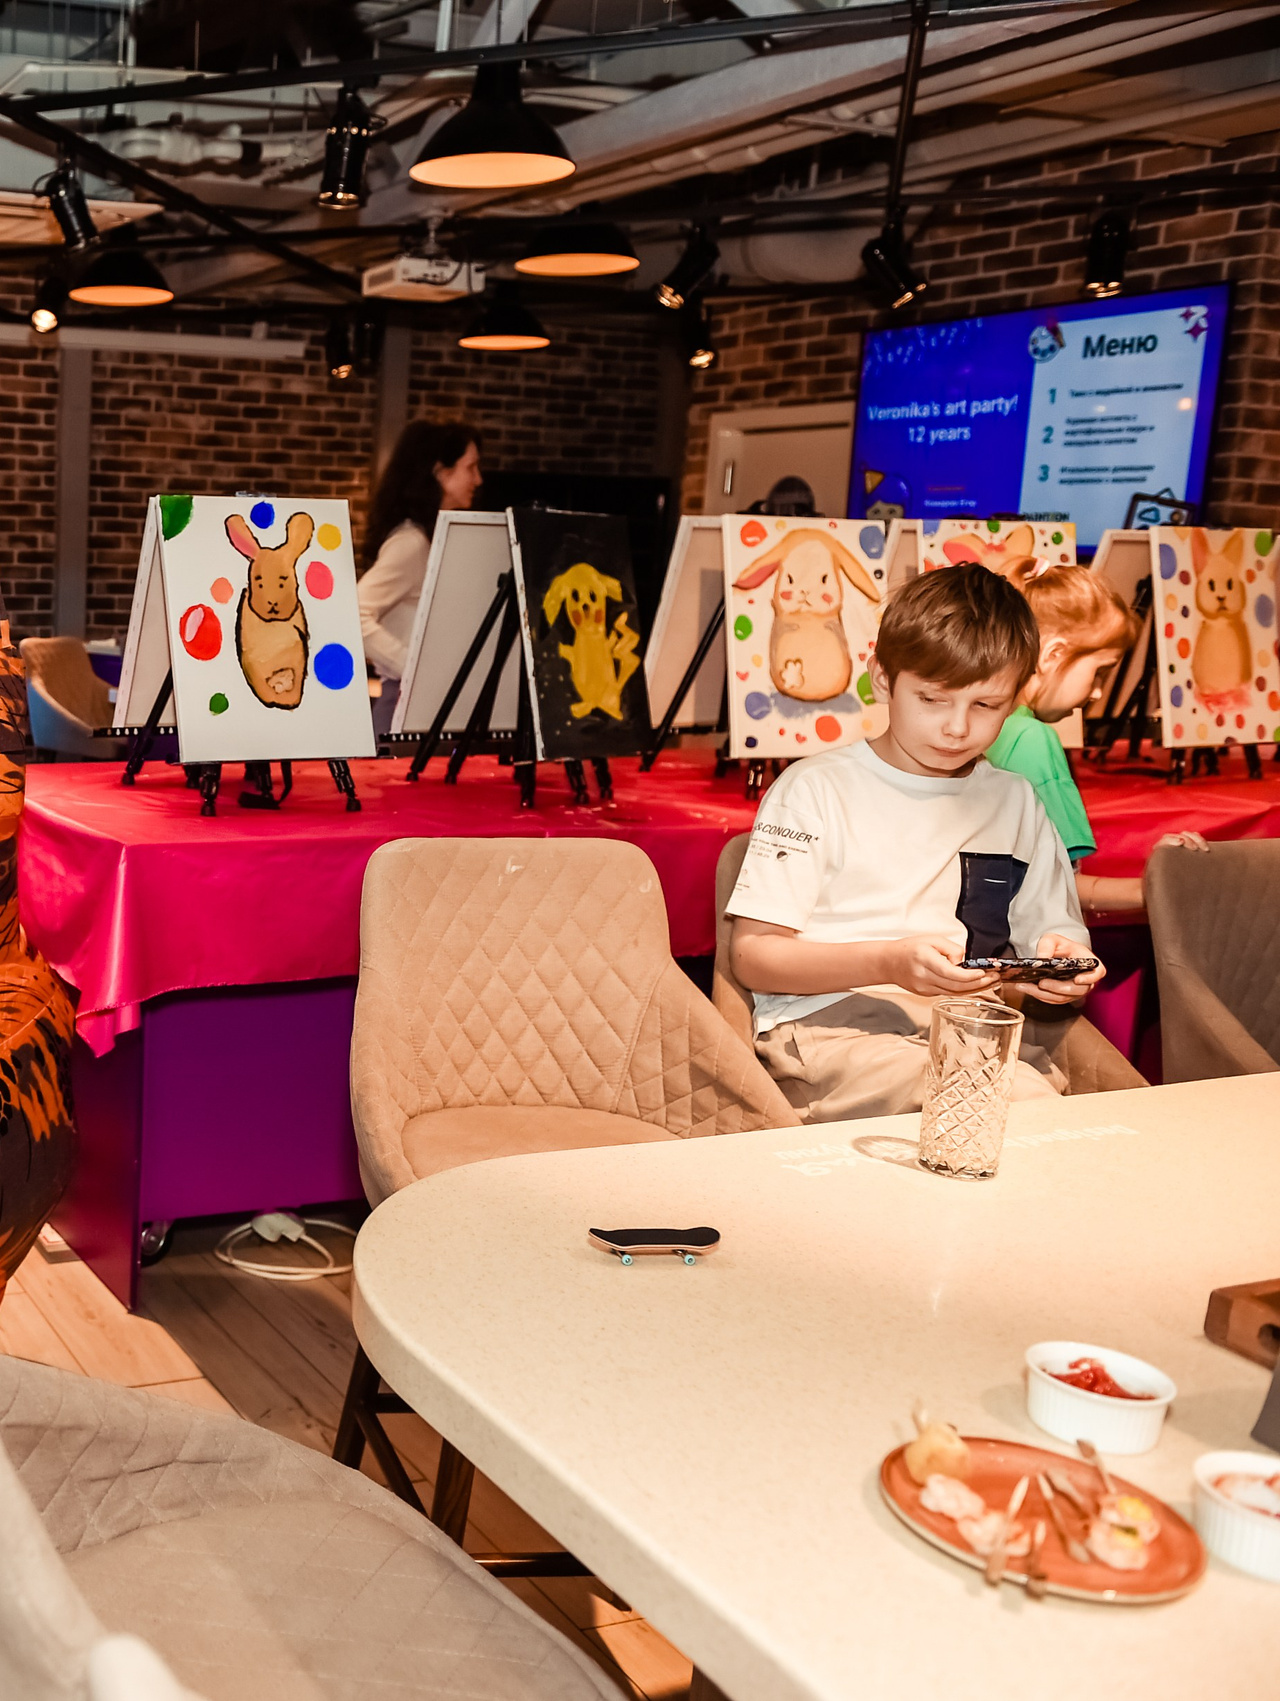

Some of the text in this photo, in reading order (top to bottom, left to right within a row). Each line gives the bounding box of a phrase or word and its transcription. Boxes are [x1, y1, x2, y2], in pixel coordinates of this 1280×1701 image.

[1082, 334, 1158, 359] Меню
[1049, 388, 1056, 405] 1
[867, 393, 1019, 421] Veronika's art party!
[909, 425, 971, 446] 12 years
[1043, 425, 1054, 444] 2
[1038, 464, 1050, 482] 3
